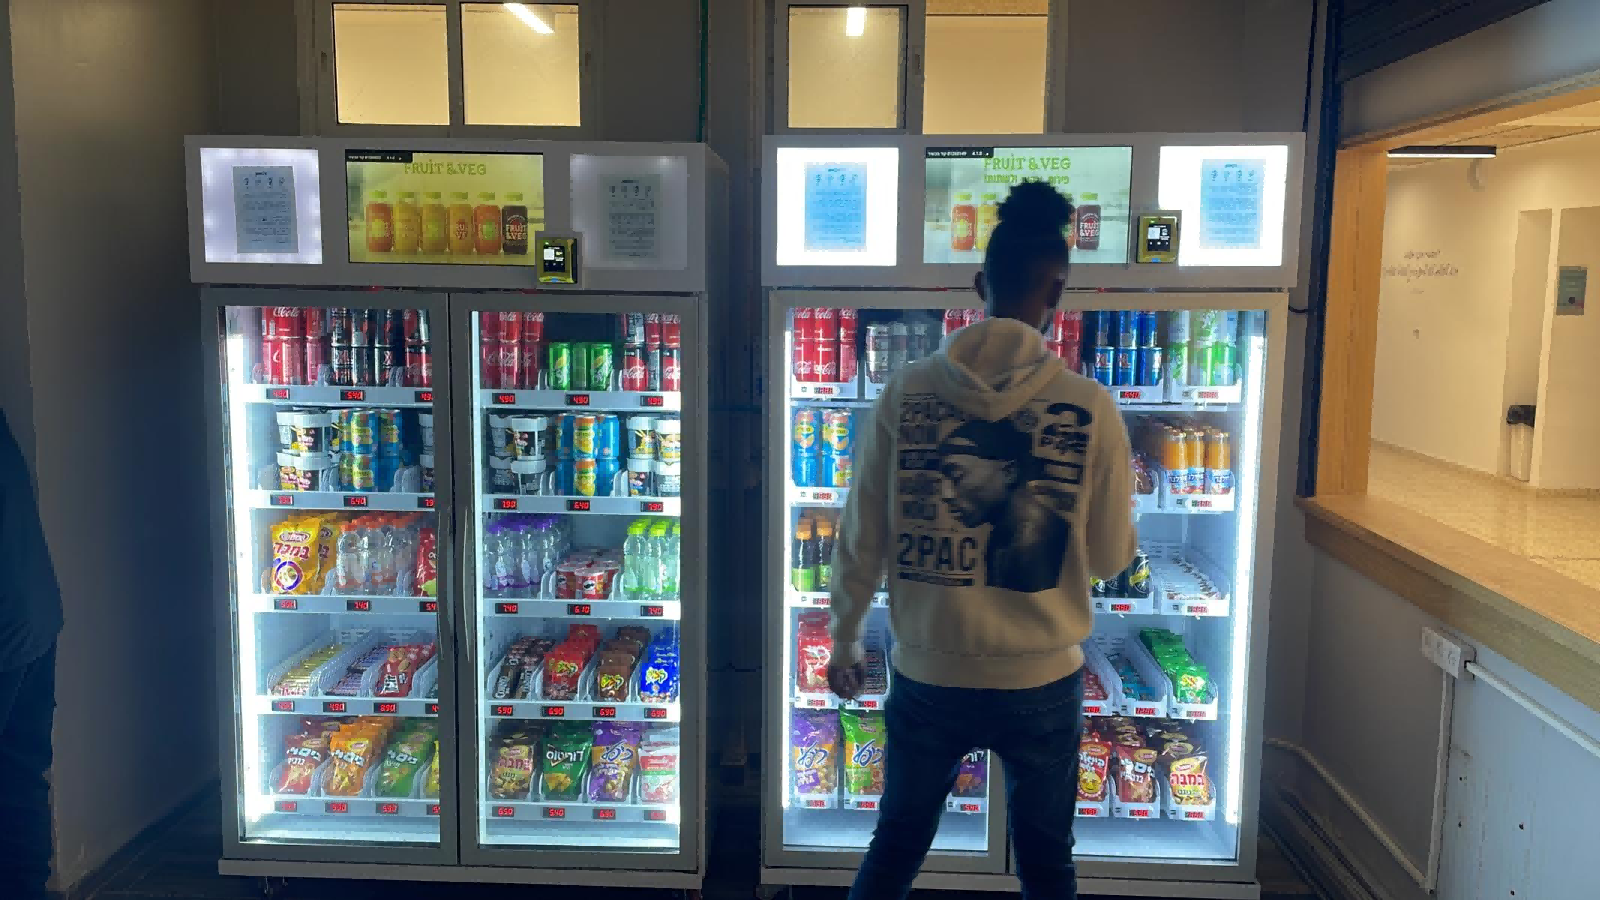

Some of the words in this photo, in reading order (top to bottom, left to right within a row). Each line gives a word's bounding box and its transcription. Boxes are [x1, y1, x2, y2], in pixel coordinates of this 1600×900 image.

[897, 532, 976, 571] 2PAC
[546, 750, 584, 763] דוריטוס
[1169, 773, 1205, 786] במבה
